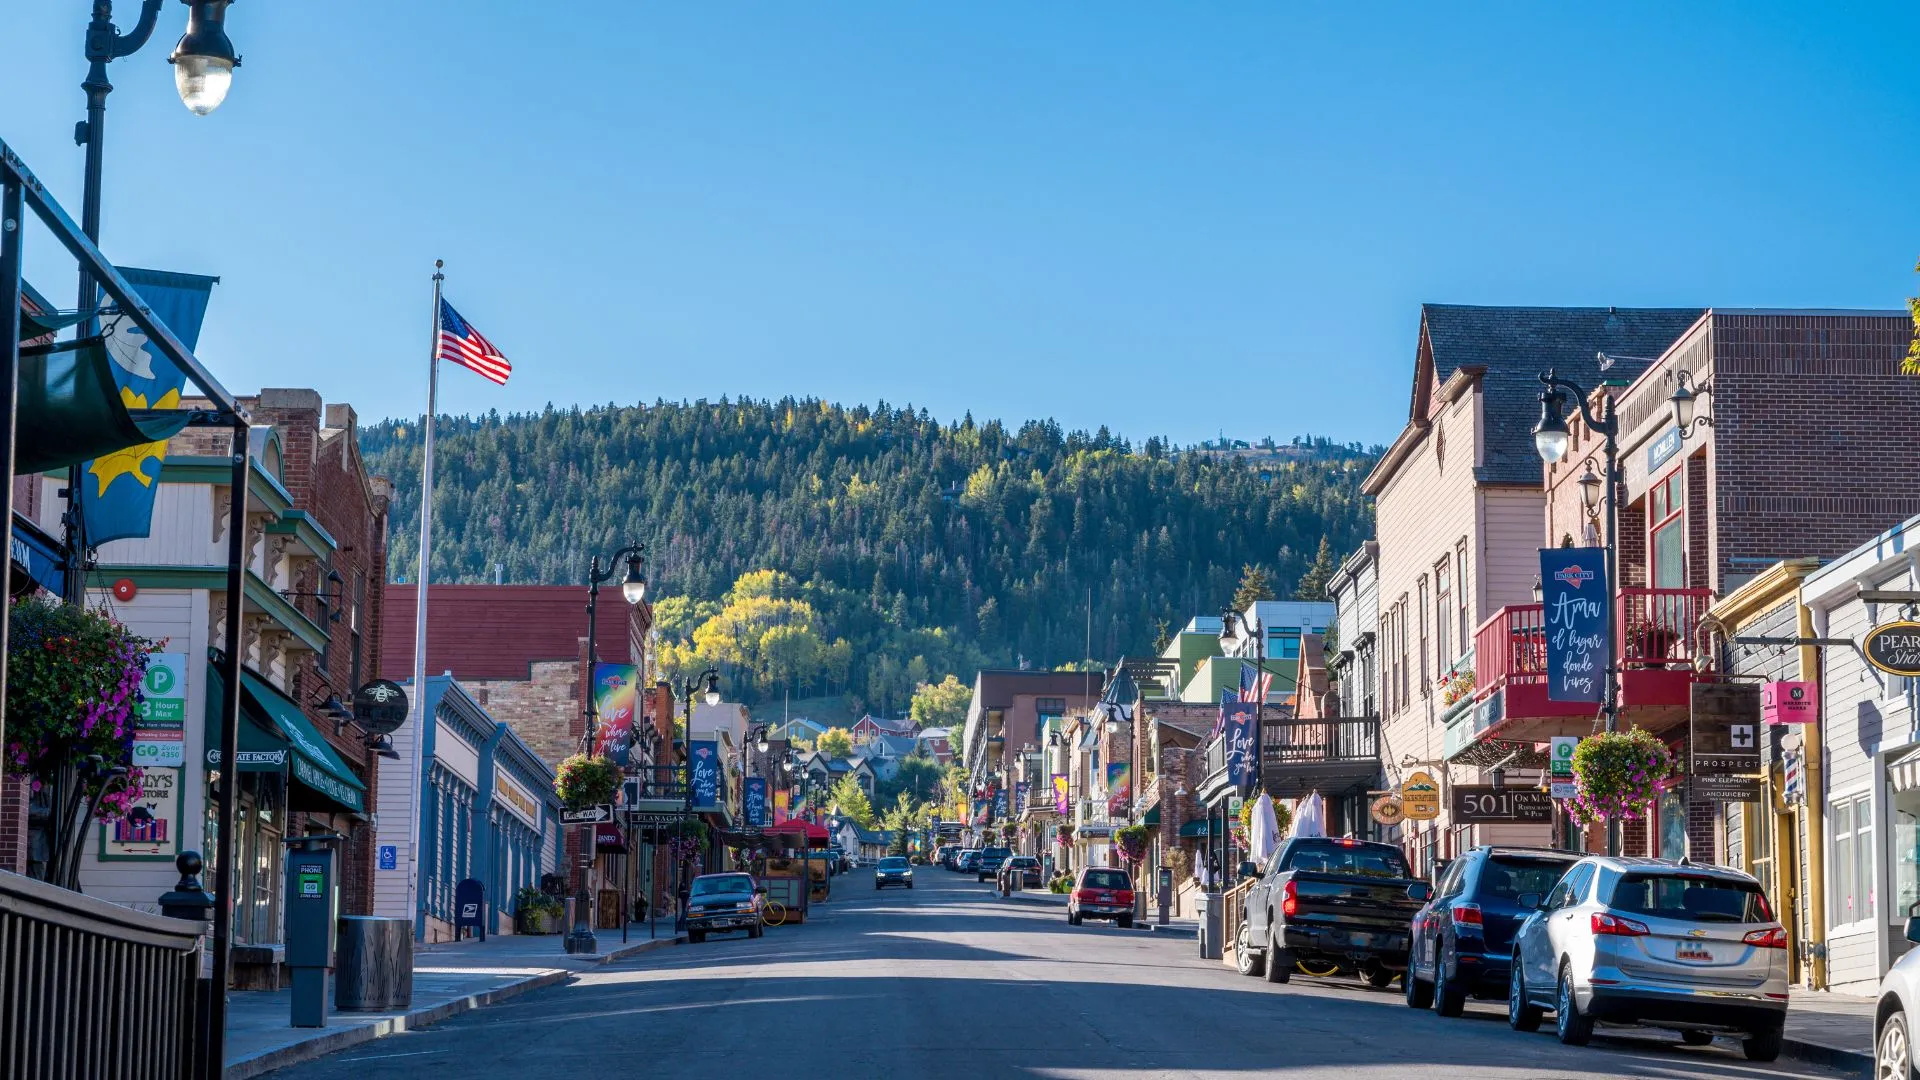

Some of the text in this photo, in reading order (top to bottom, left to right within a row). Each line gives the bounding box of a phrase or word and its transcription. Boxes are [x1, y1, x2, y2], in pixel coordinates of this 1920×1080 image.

[1550, 591, 1602, 629] Ama
[1552, 628, 1603, 654] el lugar
[1562, 650, 1594, 674] donde
[1563, 674, 1594, 694] vives
[141, 700, 179, 717] 3 Hours
[155, 710, 172, 718] Max
[1226, 727, 1255, 761] Love
[252, 750, 287, 765] FACTORY
[1555, 761, 1561, 771] 3
[1695, 760, 1759, 768] PROSPECT
[690, 760, 714, 786] Love
[564, 810, 598, 819] ONE WAY
[1463, 794, 1510, 815] 501
